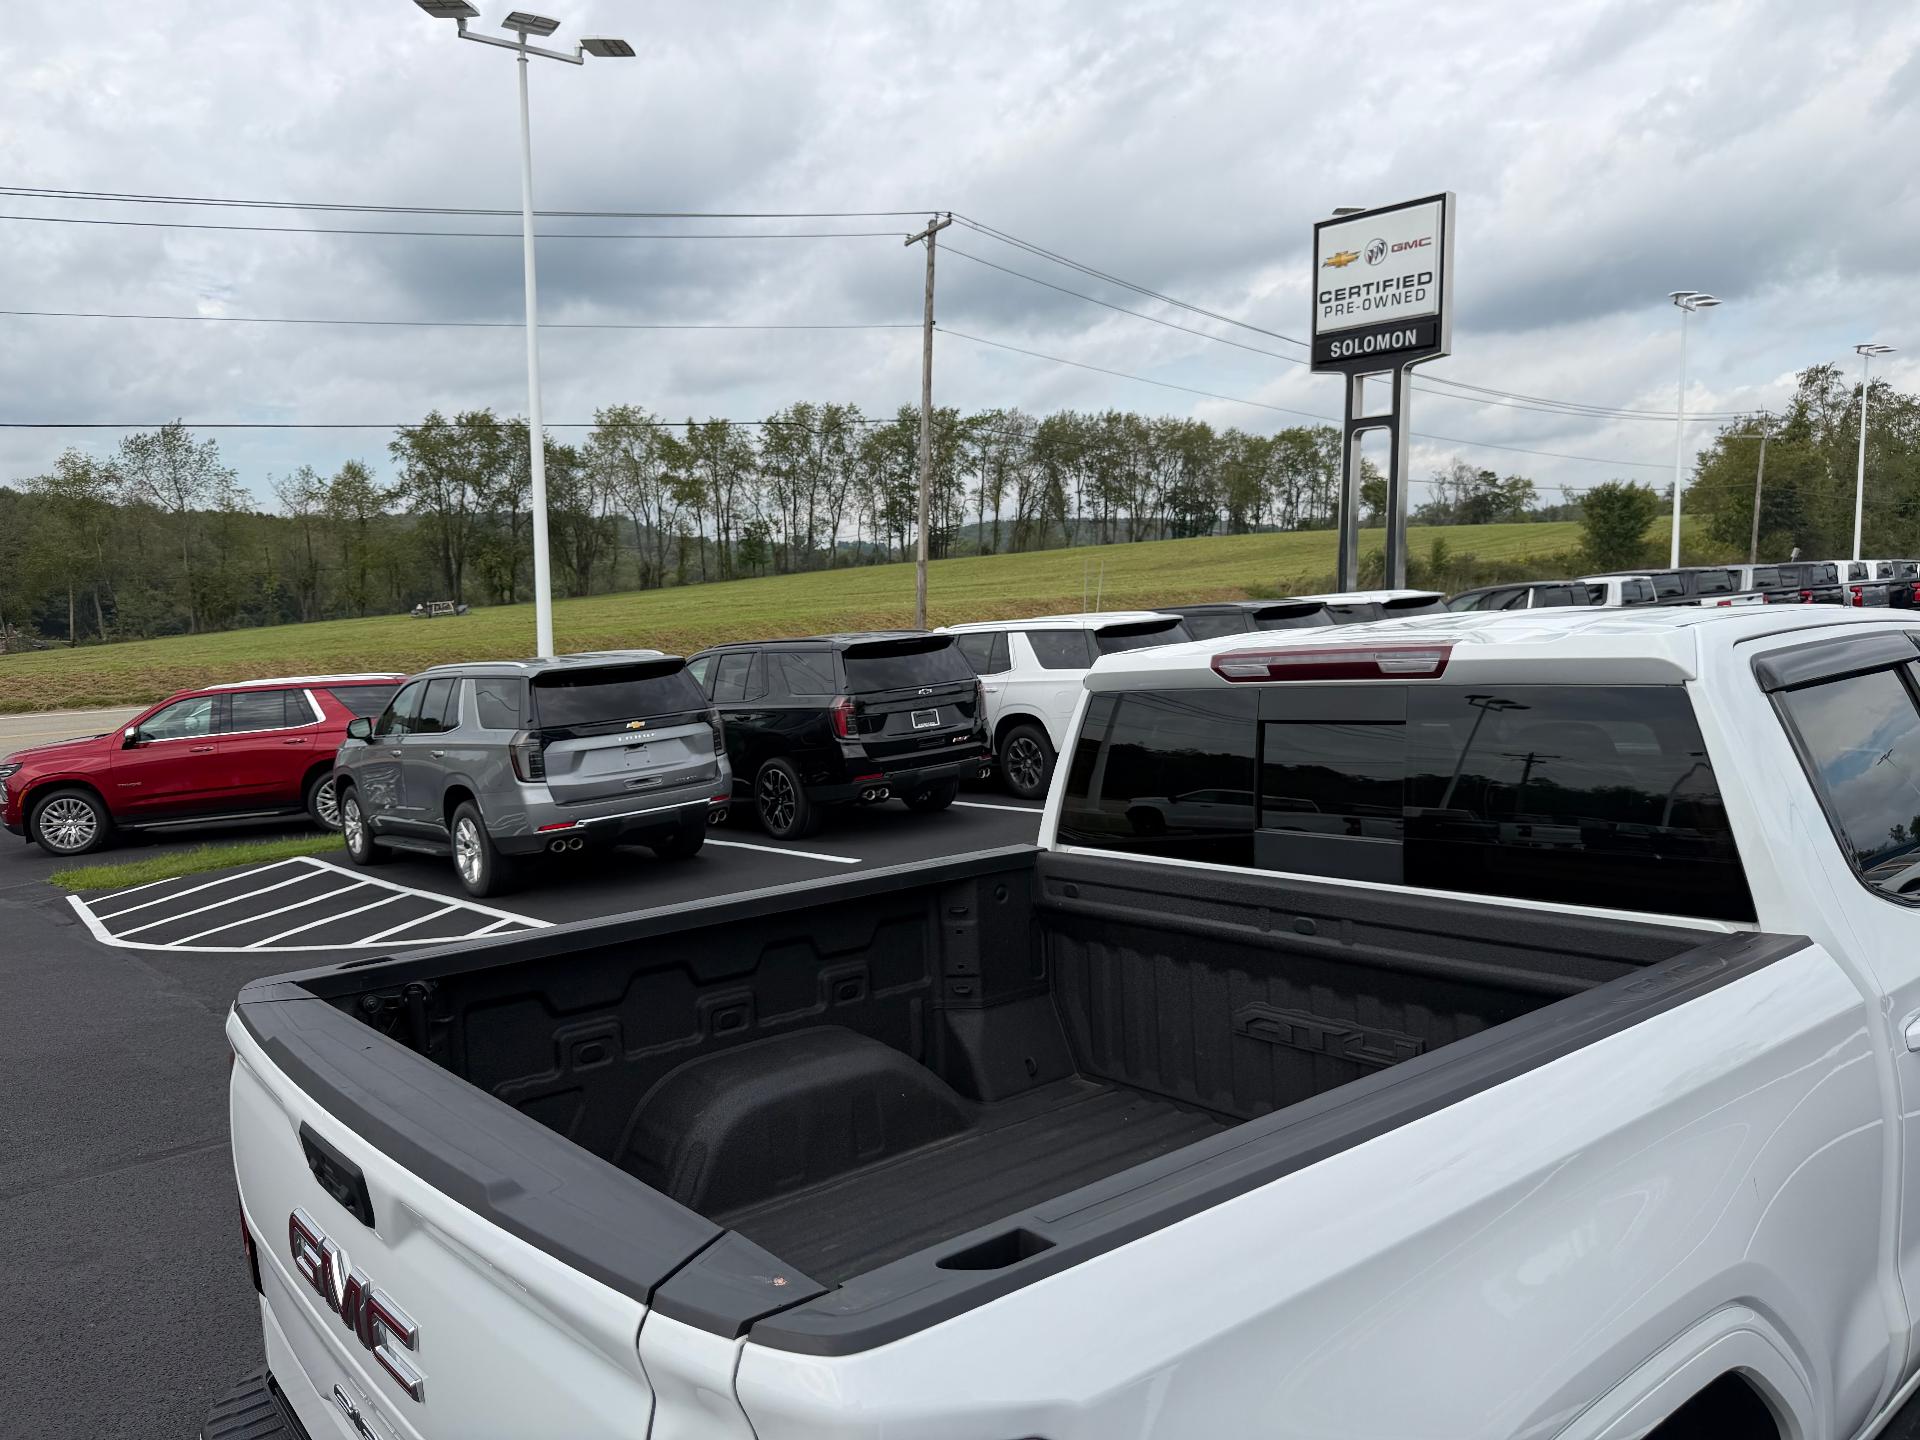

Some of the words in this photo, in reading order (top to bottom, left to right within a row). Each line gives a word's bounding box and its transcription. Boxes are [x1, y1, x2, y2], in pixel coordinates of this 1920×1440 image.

[1391, 236, 1432, 253] GMC
[1319, 271, 1433, 304] CERTIFIED
[1324, 288, 1426, 318] PRE-OWNED
[1330, 328, 1417, 358] SOLOMON
[289, 1207, 426, 1403] GMC
